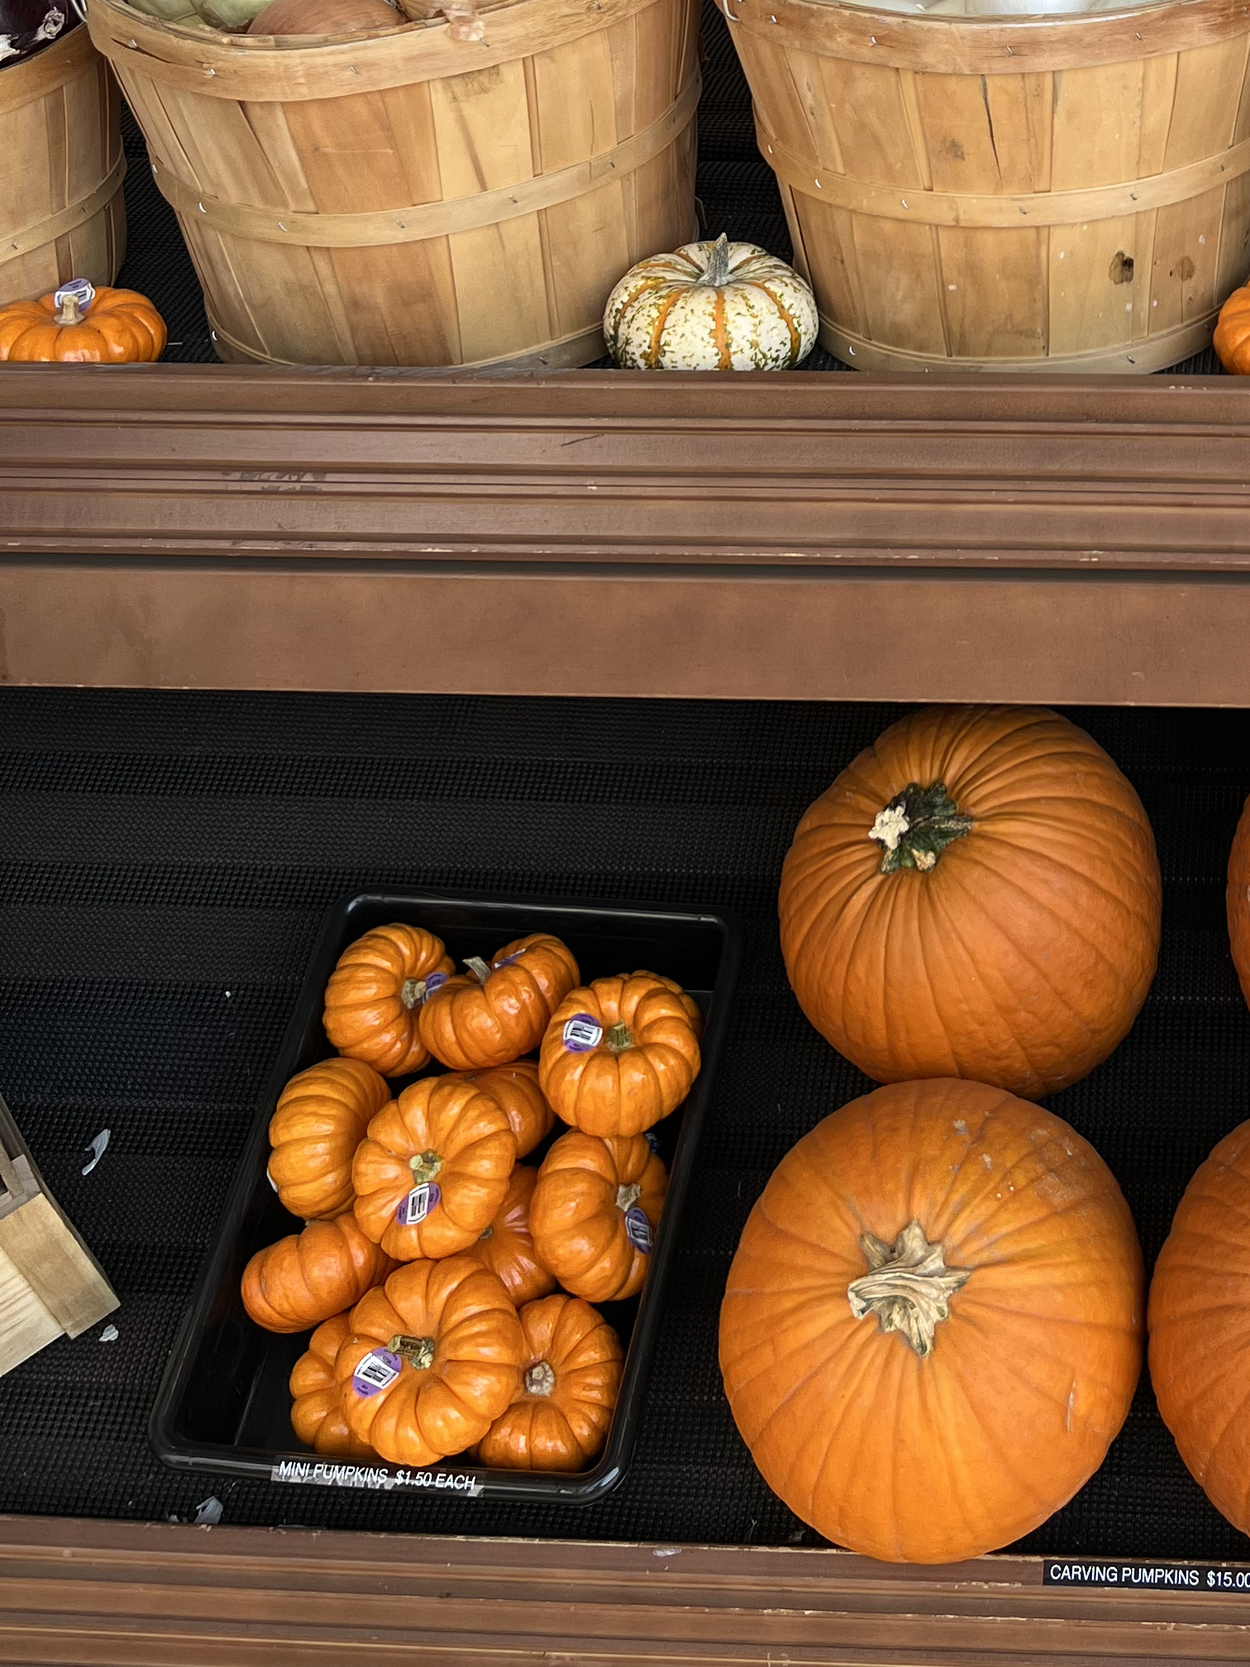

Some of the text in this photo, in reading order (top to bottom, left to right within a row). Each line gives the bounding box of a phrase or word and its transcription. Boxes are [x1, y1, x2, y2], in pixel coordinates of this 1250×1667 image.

[278, 1460, 476, 1490] MINI PUMPKINS $1.50 EACH
[1050, 1564, 1119, 1582] CARVING
[1121, 1567, 1200, 1586] PUMPKINS
